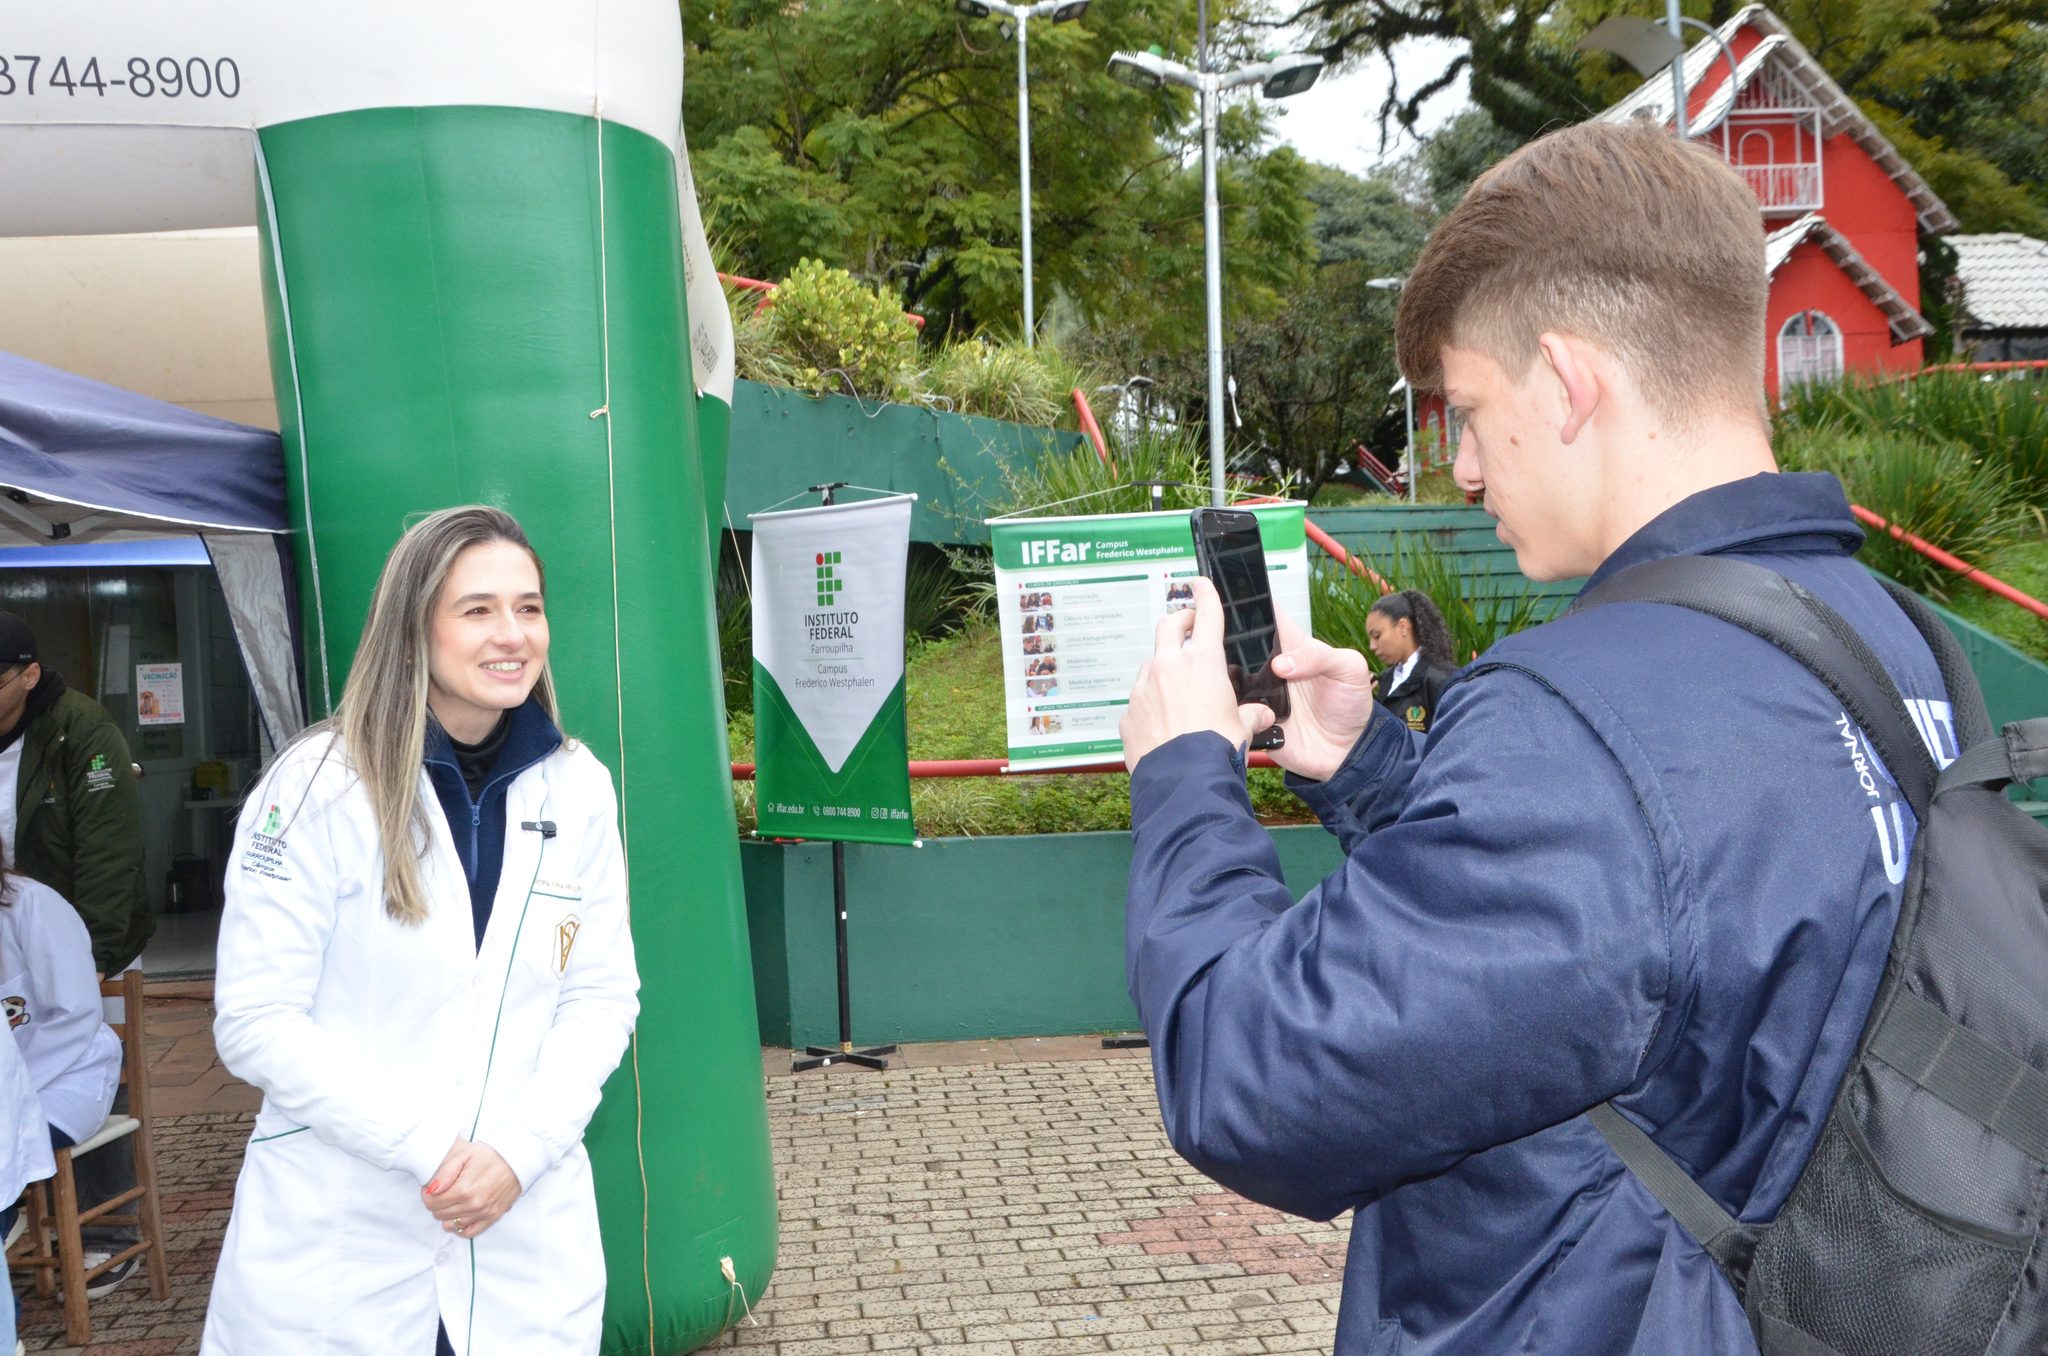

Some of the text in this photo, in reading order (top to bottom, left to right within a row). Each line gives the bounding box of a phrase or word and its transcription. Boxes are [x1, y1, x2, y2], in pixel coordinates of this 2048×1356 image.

[1021, 539, 1091, 564] IFFar
[1095, 540, 1128, 550] Campus
[1096, 545, 1184, 559] Frederico Westphalen
[804, 612, 858, 627] INSTITUTO
[809, 626, 854, 640] FEDERAL
[811, 643, 853, 655] Farroupilha
[817, 664, 847, 676] Campus
[795, 676, 874, 689] Frederico Westphalen
[1836, 712, 1880, 799] JORNAL
[776, 803, 805, 814] iffar.edu.br
[822, 806, 836, 816] 0800
[836, 807, 847, 817] 744
[847, 807, 861, 818] 8900
[251, 841, 282, 857] FEDERAL
